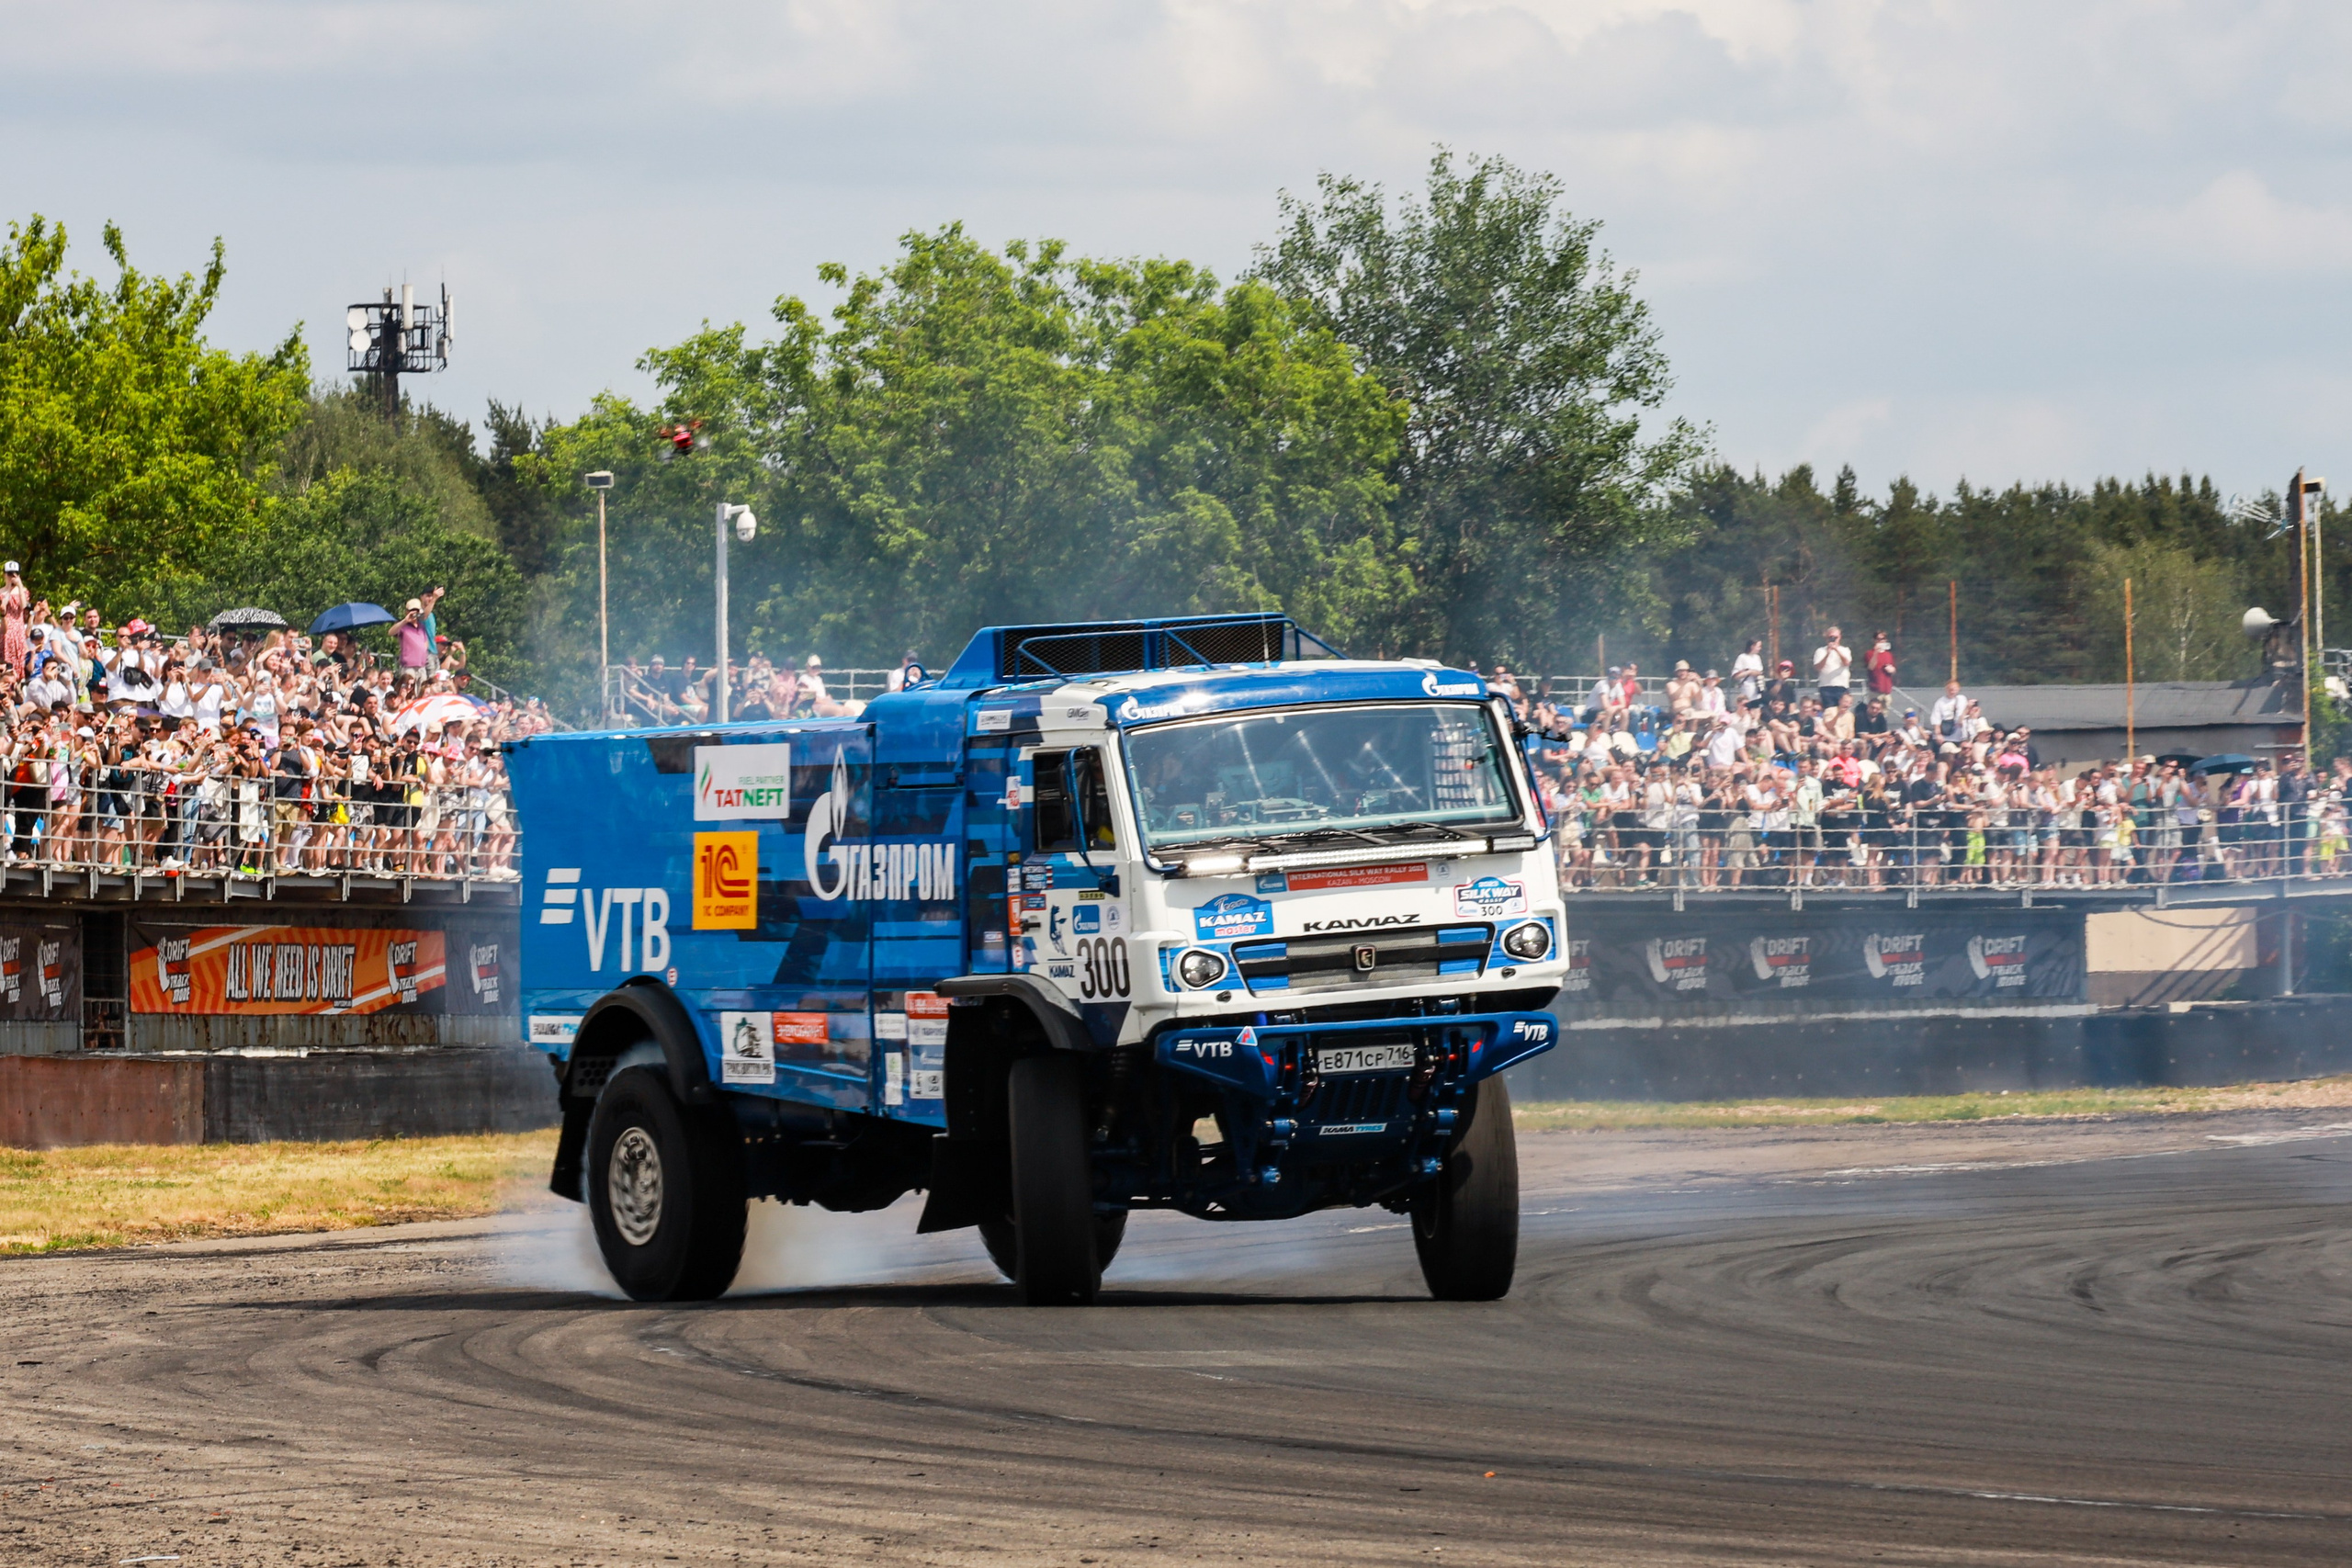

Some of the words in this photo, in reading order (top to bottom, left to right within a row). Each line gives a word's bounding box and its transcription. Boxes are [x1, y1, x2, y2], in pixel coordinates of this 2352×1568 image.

[714, 787, 785, 807] TATNEFT
[846, 843, 956, 901] ГАЗПРОМ
[1289, 870, 1348, 881] INTERNATIONAL
[1349, 869, 1365, 877] SILK
[1327, 877, 1352, 886] KAZAN
[1358, 875, 1392, 885] MOSCOW
[1460, 887, 1491, 900] SILK
[1491, 886, 1520, 898] WAY
[1214, 896, 1249, 914] Team
[1481, 905, 1503, 916] 300
[1199, 911, 1267, 929] KAMAZ
[1303, 913, 1420, 932] KAMAZ
[582, 887, 672, 973] VTB
[1215, 924, 1257, 937] master
[166, 938, 190, 963] DRIFT
[1664, 938, 1707, 958] DRIFT
[1767, 937, 1811, 955] DRIFT
[1882, 934, 1925, 953] DRIFT
[1984, 935, 2027, 955] DRIFT
[394, 942, 418, 964] DRIFT
[226, 944, 248, 998] ALL
[252, 944, 272, 998] WE
[274, 944, 304, 999] NEED
[306, 944, 320, 999] IS
[322, 945, 356, 998] DRIFT
[1048, 964, 1076, 978] KAMAZ
[1077, 936, 1131, 999] 300
[1524, 1024, 1549, 1041] VTB
[1193, 1041, 1233, 1058] VTB
[1385, 1046, 1410, 1061] 716
